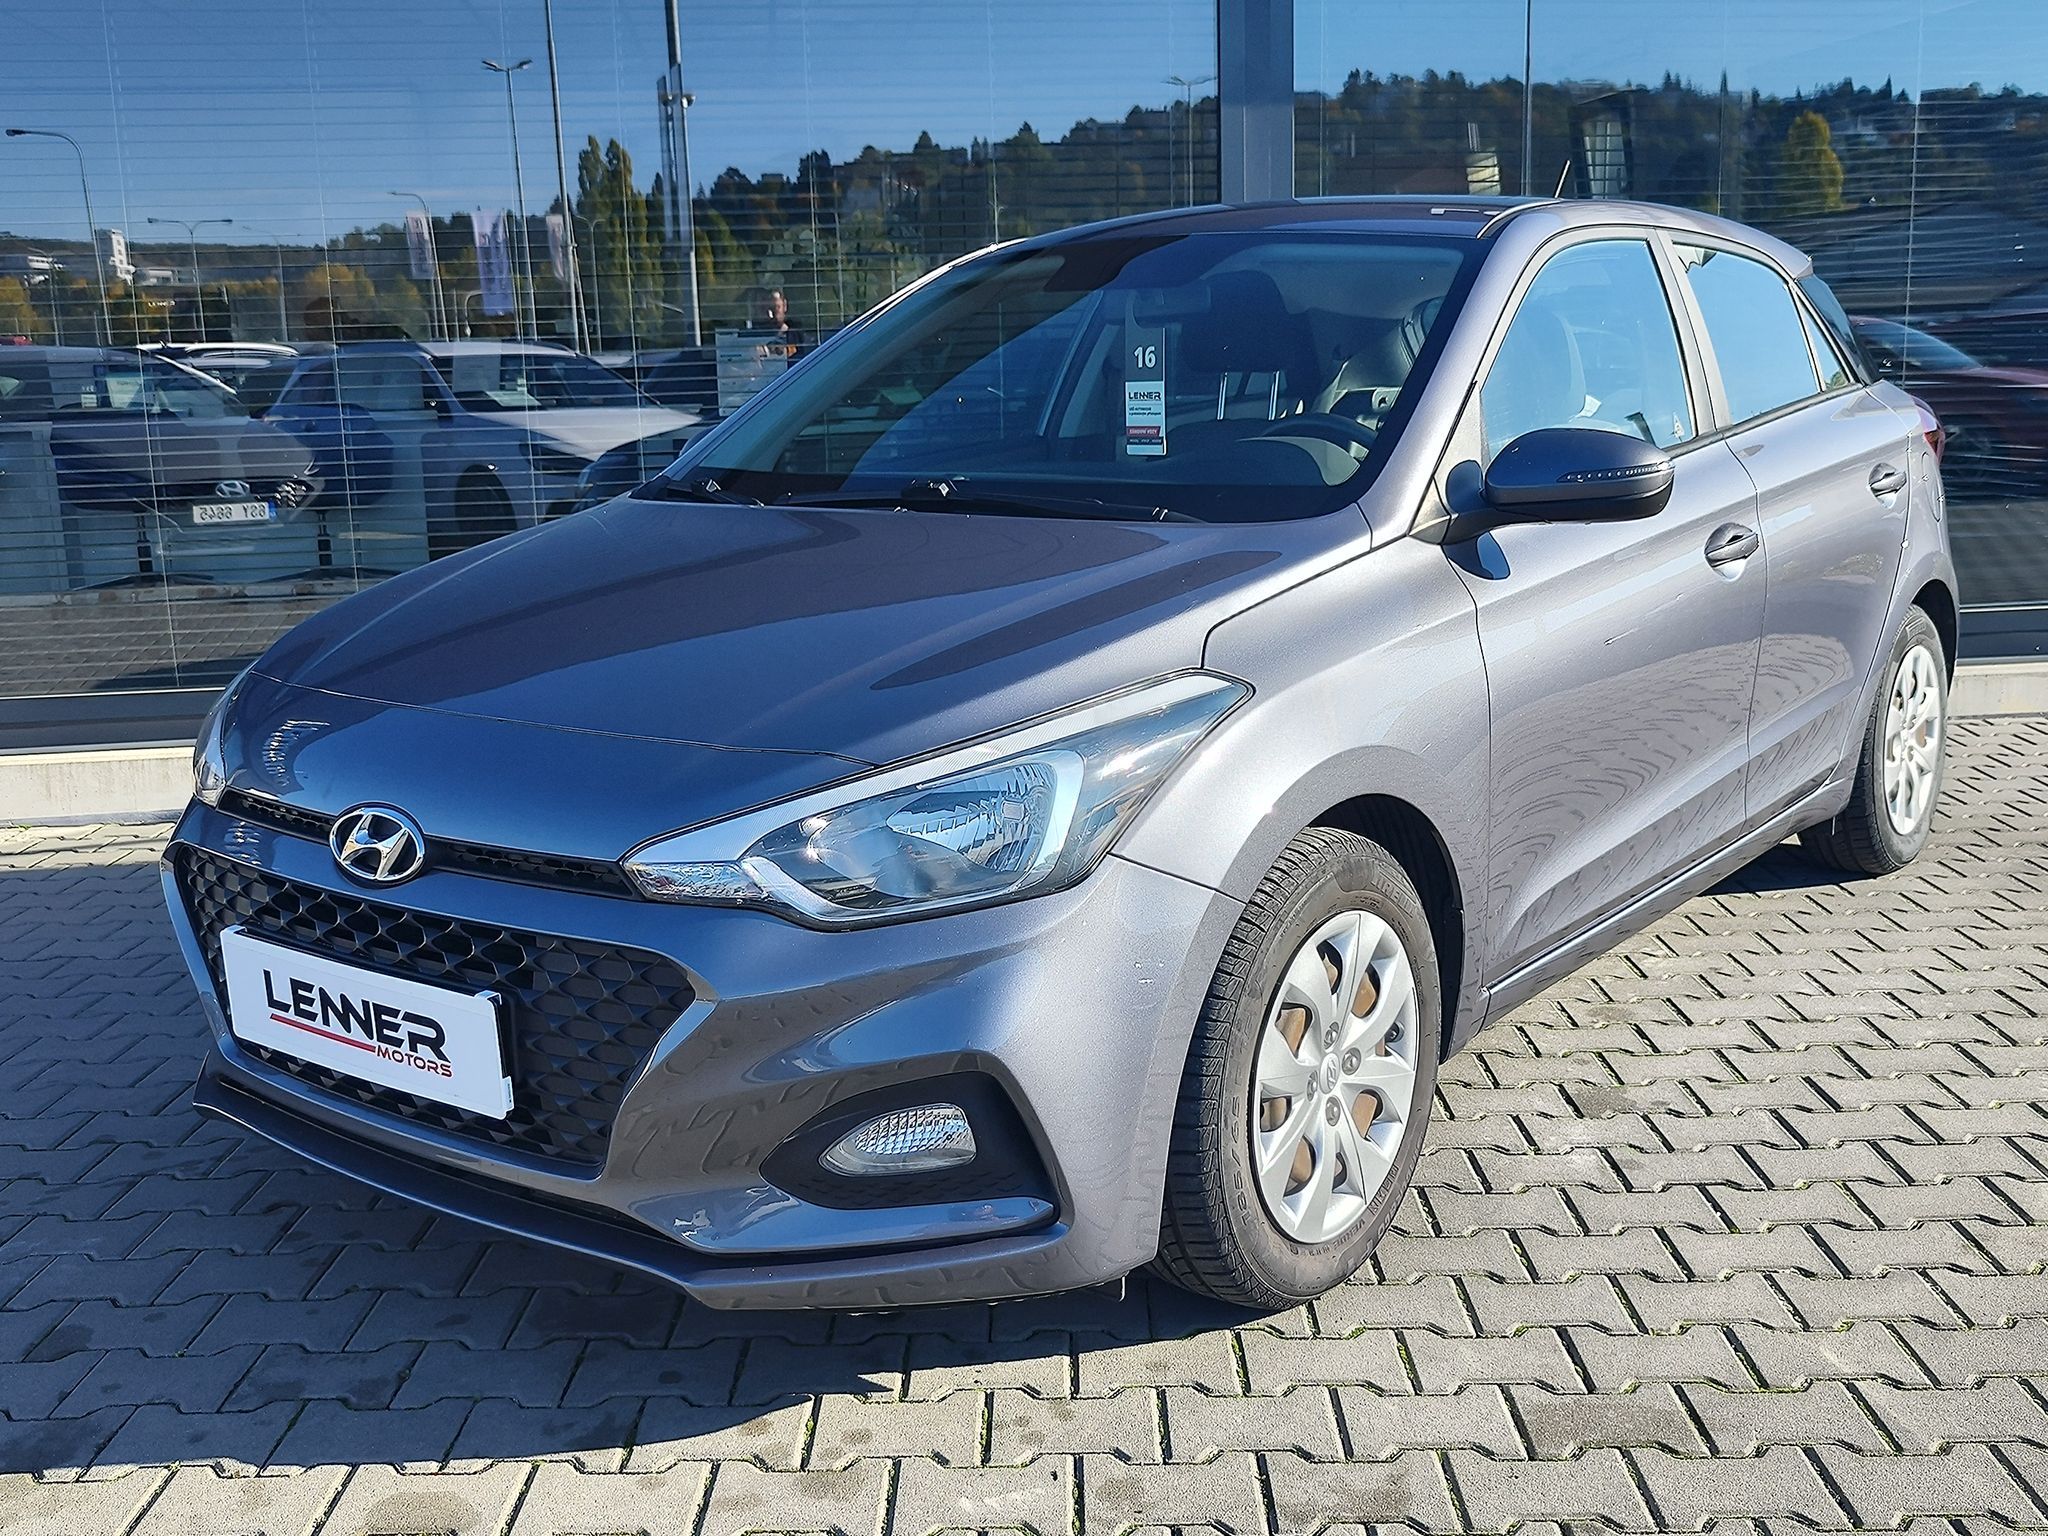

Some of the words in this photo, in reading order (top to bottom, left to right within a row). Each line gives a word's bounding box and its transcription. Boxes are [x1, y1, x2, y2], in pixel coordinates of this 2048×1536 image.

[1133, 345, 1156, 369] 16
[1128, 391, 1162, 400] LENNER
[262, 968, 452, 1063] LENNER
[376, 1045, 453, 1078] MOTORS
